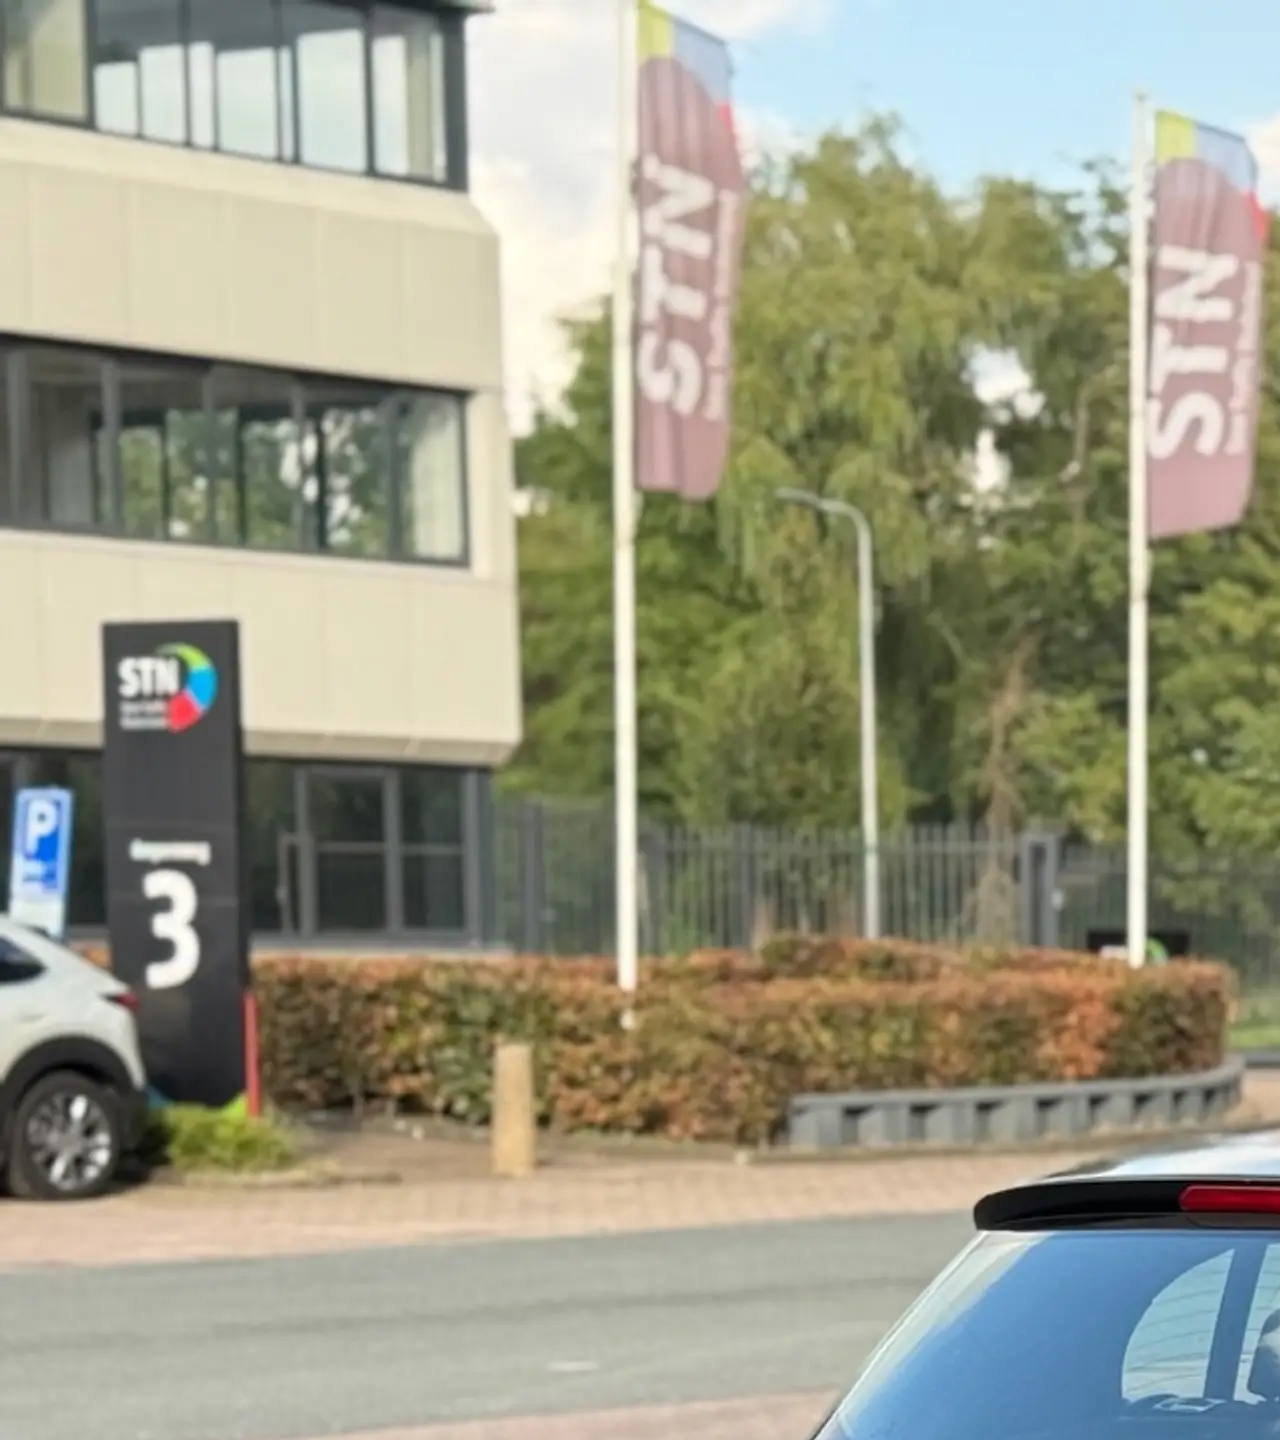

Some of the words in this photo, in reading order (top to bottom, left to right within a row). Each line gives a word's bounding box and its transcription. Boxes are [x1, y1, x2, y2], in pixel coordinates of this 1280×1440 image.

[638, 152, 715, 417] STN
[1149, 245, 1239, 458] STN
[117, 656, 180, 698] STN
[26, 799, 57, 857] P
[142, 868, 201, 990] 3
